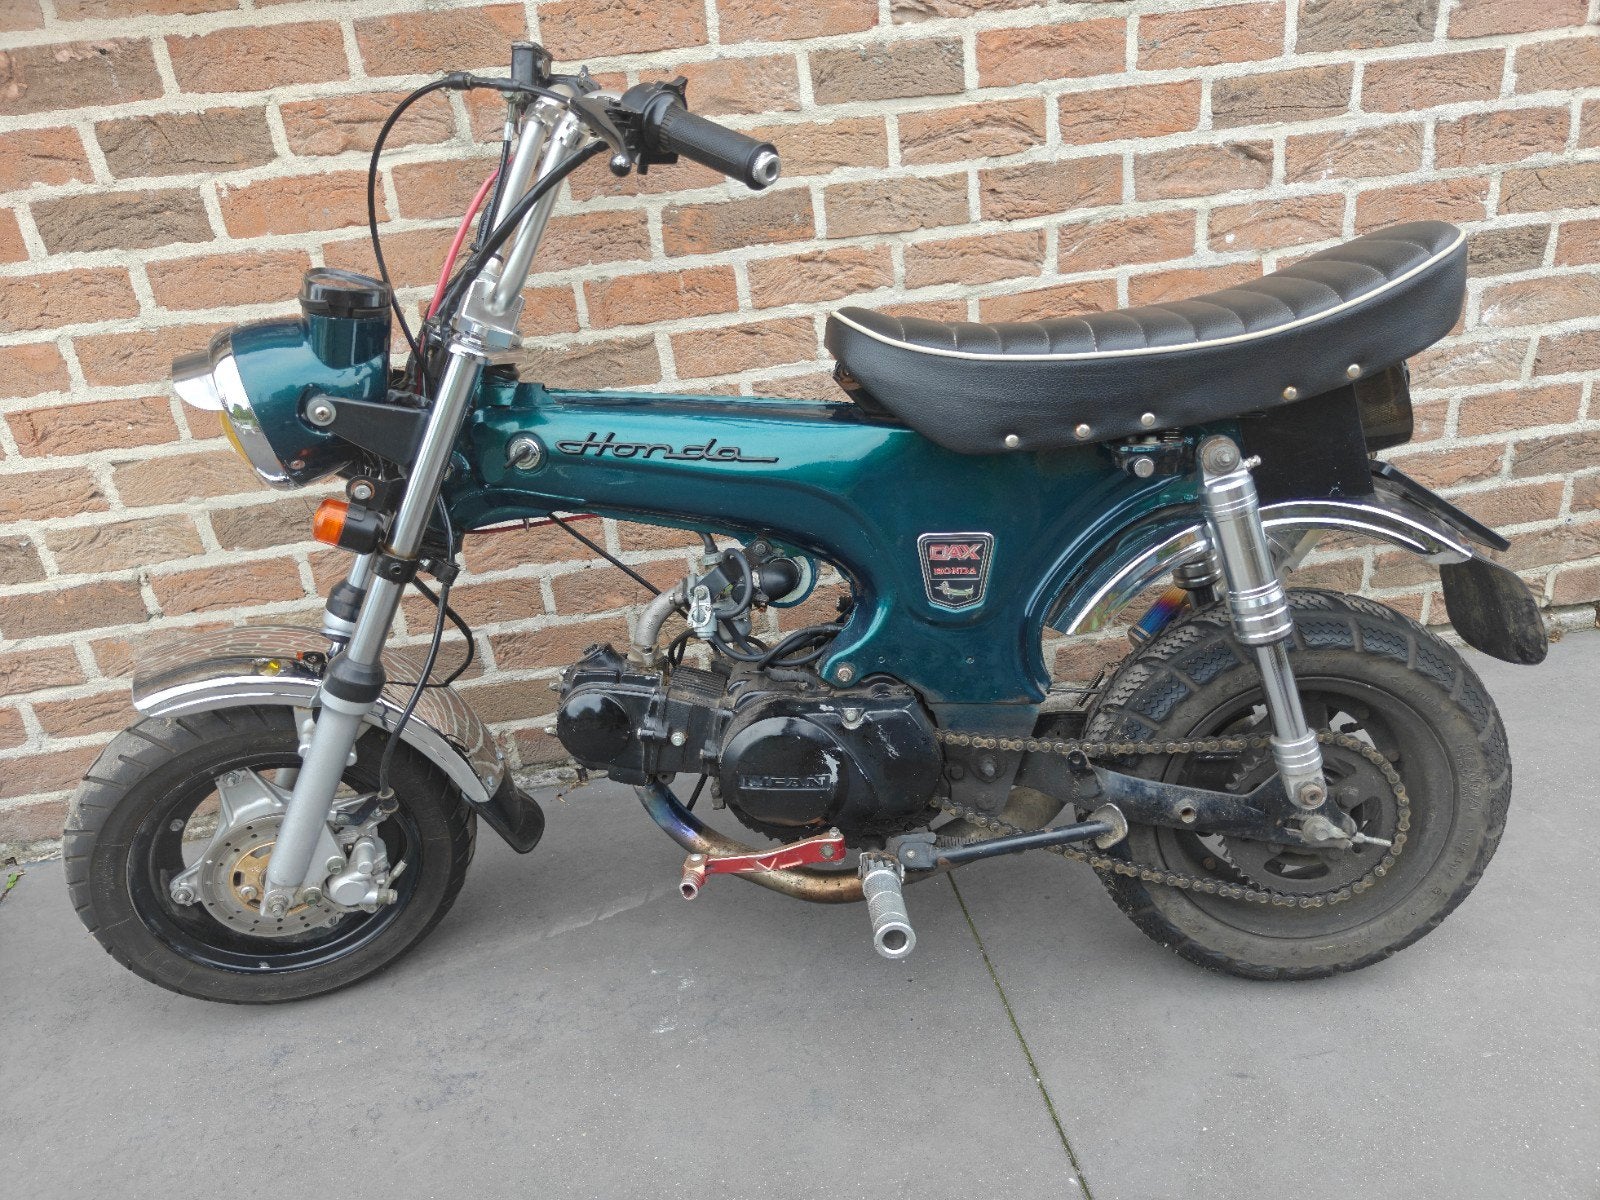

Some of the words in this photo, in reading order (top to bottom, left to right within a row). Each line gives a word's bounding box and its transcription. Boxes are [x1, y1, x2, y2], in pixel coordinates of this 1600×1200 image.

[555, 431, 779, 462] Honda
[929, 543, 983, 561] DAX
[933, 566, 977, 576] HONDA
[746, 775, 826, 788] LIFAN
